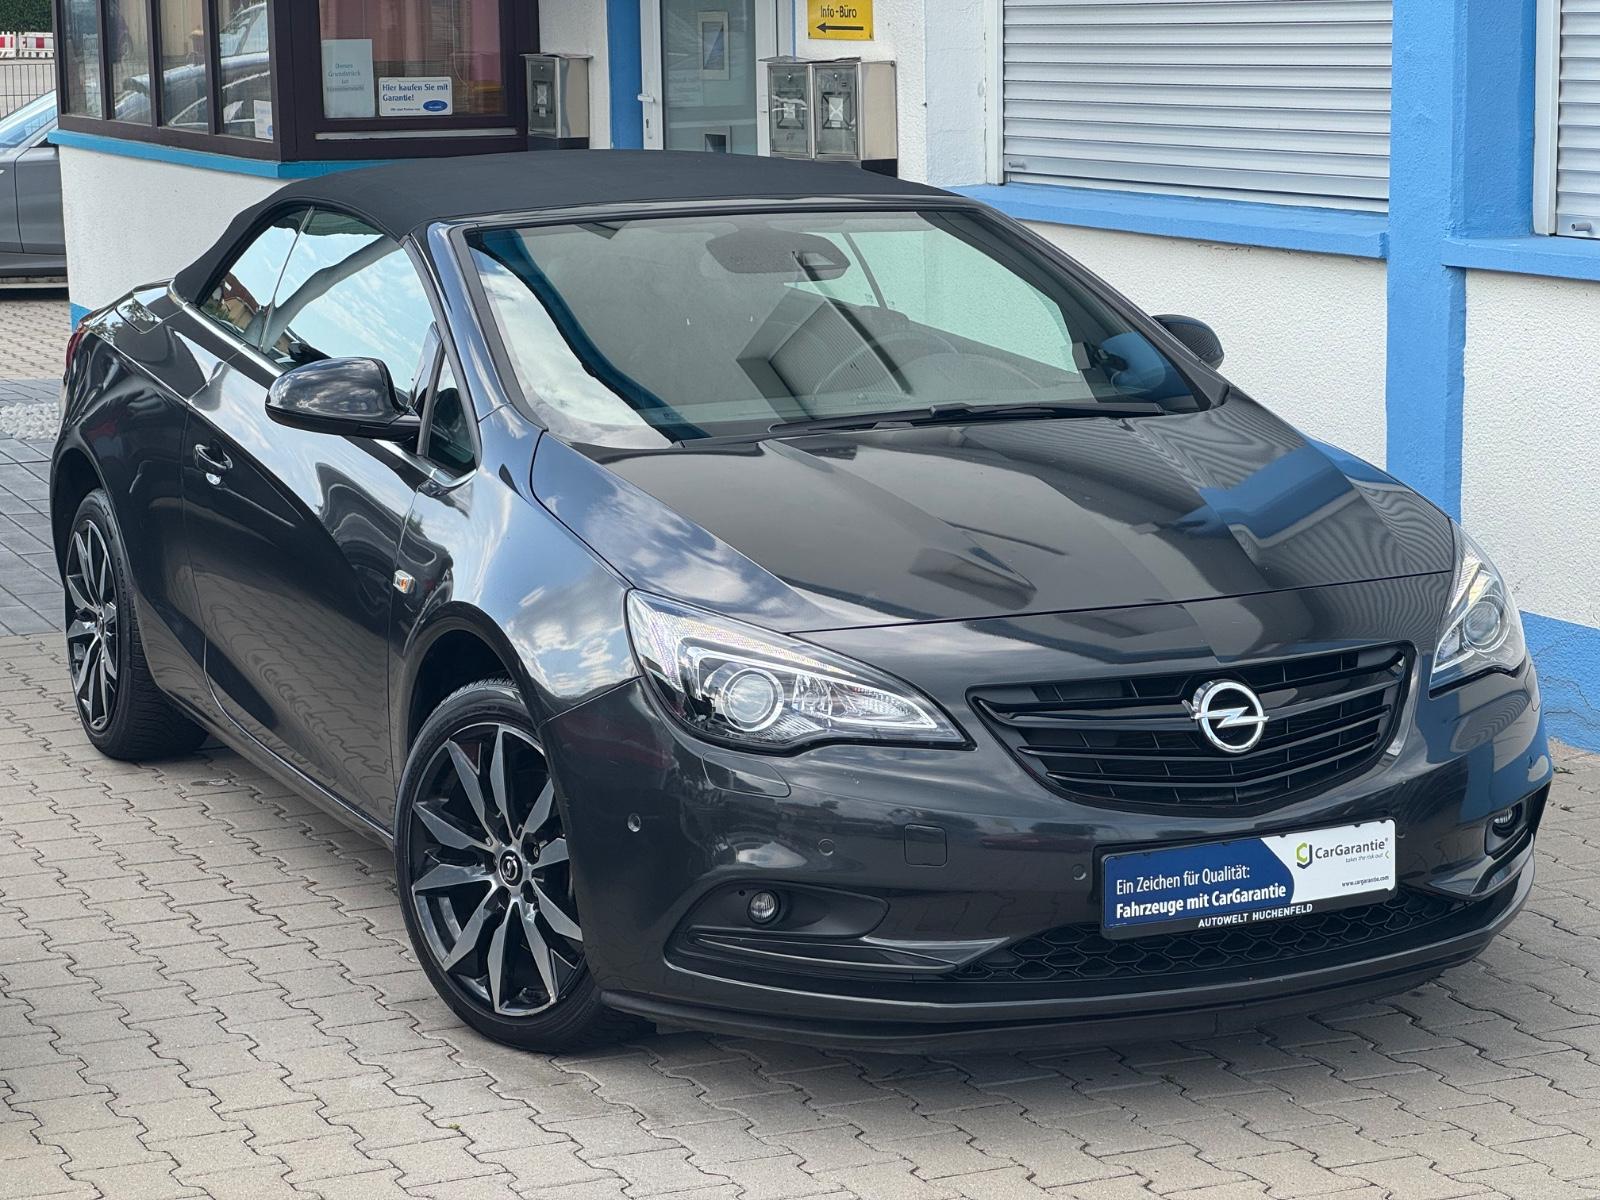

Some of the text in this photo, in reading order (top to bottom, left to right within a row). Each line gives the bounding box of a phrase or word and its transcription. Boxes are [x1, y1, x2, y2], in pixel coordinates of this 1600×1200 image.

[820, 4, 857, 18] Info-Büro
[1116, 865, 1250, 895] Ein Zeichen für Qualität:
[1116, 882, 1287, 919] Fahrzeuge mit CarGarantie
[1198, 904, 1313, 928] AUTOWELT HUCHENFELD
